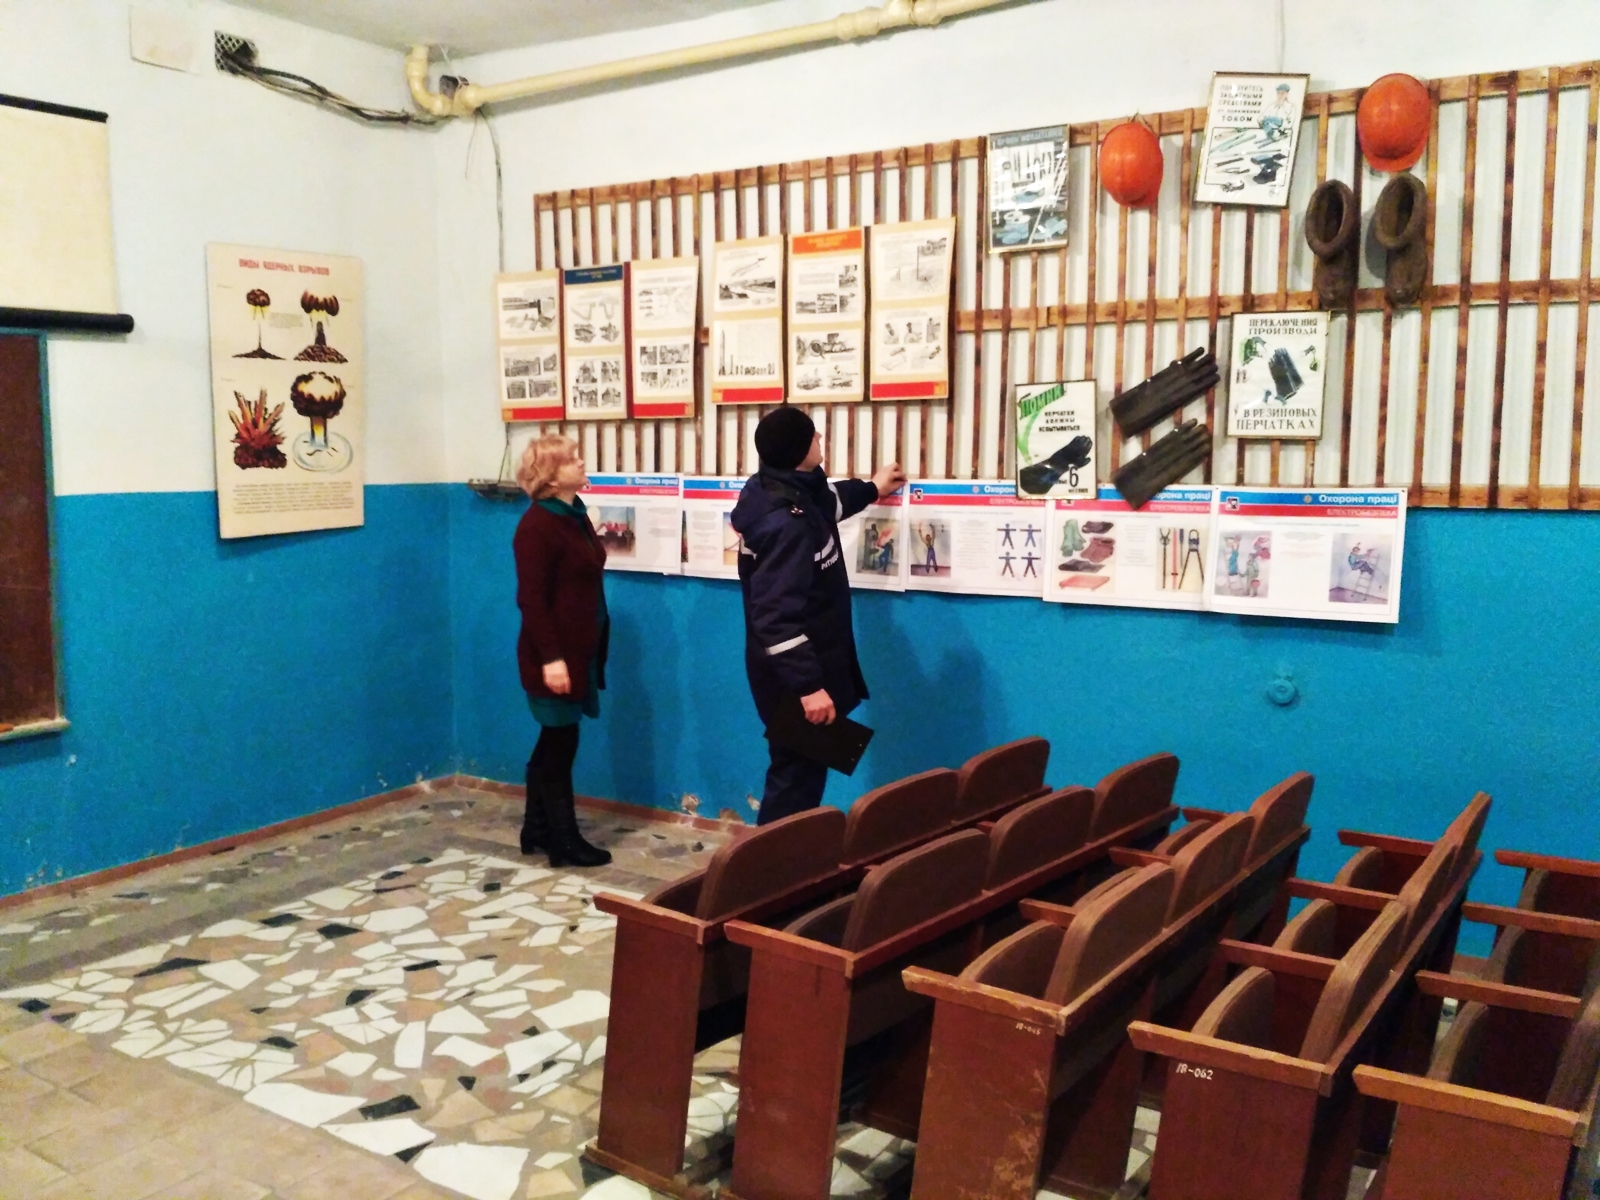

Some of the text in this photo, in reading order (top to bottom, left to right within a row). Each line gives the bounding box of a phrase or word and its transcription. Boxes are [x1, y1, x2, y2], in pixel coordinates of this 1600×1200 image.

[1218, 99, 1262, 107] СРЕДСТВАМИ
[239, 258, 330, 276] ВИДЫ ЯДЕРНЫХ ВЗРЫВОВ
[1248, 327, 1317, 335] ПРОИЗВОДИ
[1019, 383, 1065, 420] ПОМНИ
[1243, 408, 1250, 418] В
[1252, 407, 1318, 418] РЕЗИНОВЫХ
[1038, 424, 1080, 433] ИСПЫТЫВАТЬСЯ
[1236, 419, 1315, 431] ПЕРЧАТКАХ
[635, 477, 660, 486] Охорона
[1069, 466, 1079, 488] 6
[984, 485, 1016, 495] Охорон
[1155, 491, 1211, 501] орона праці
[1319, 494, 1397, 505] Охорона праці
